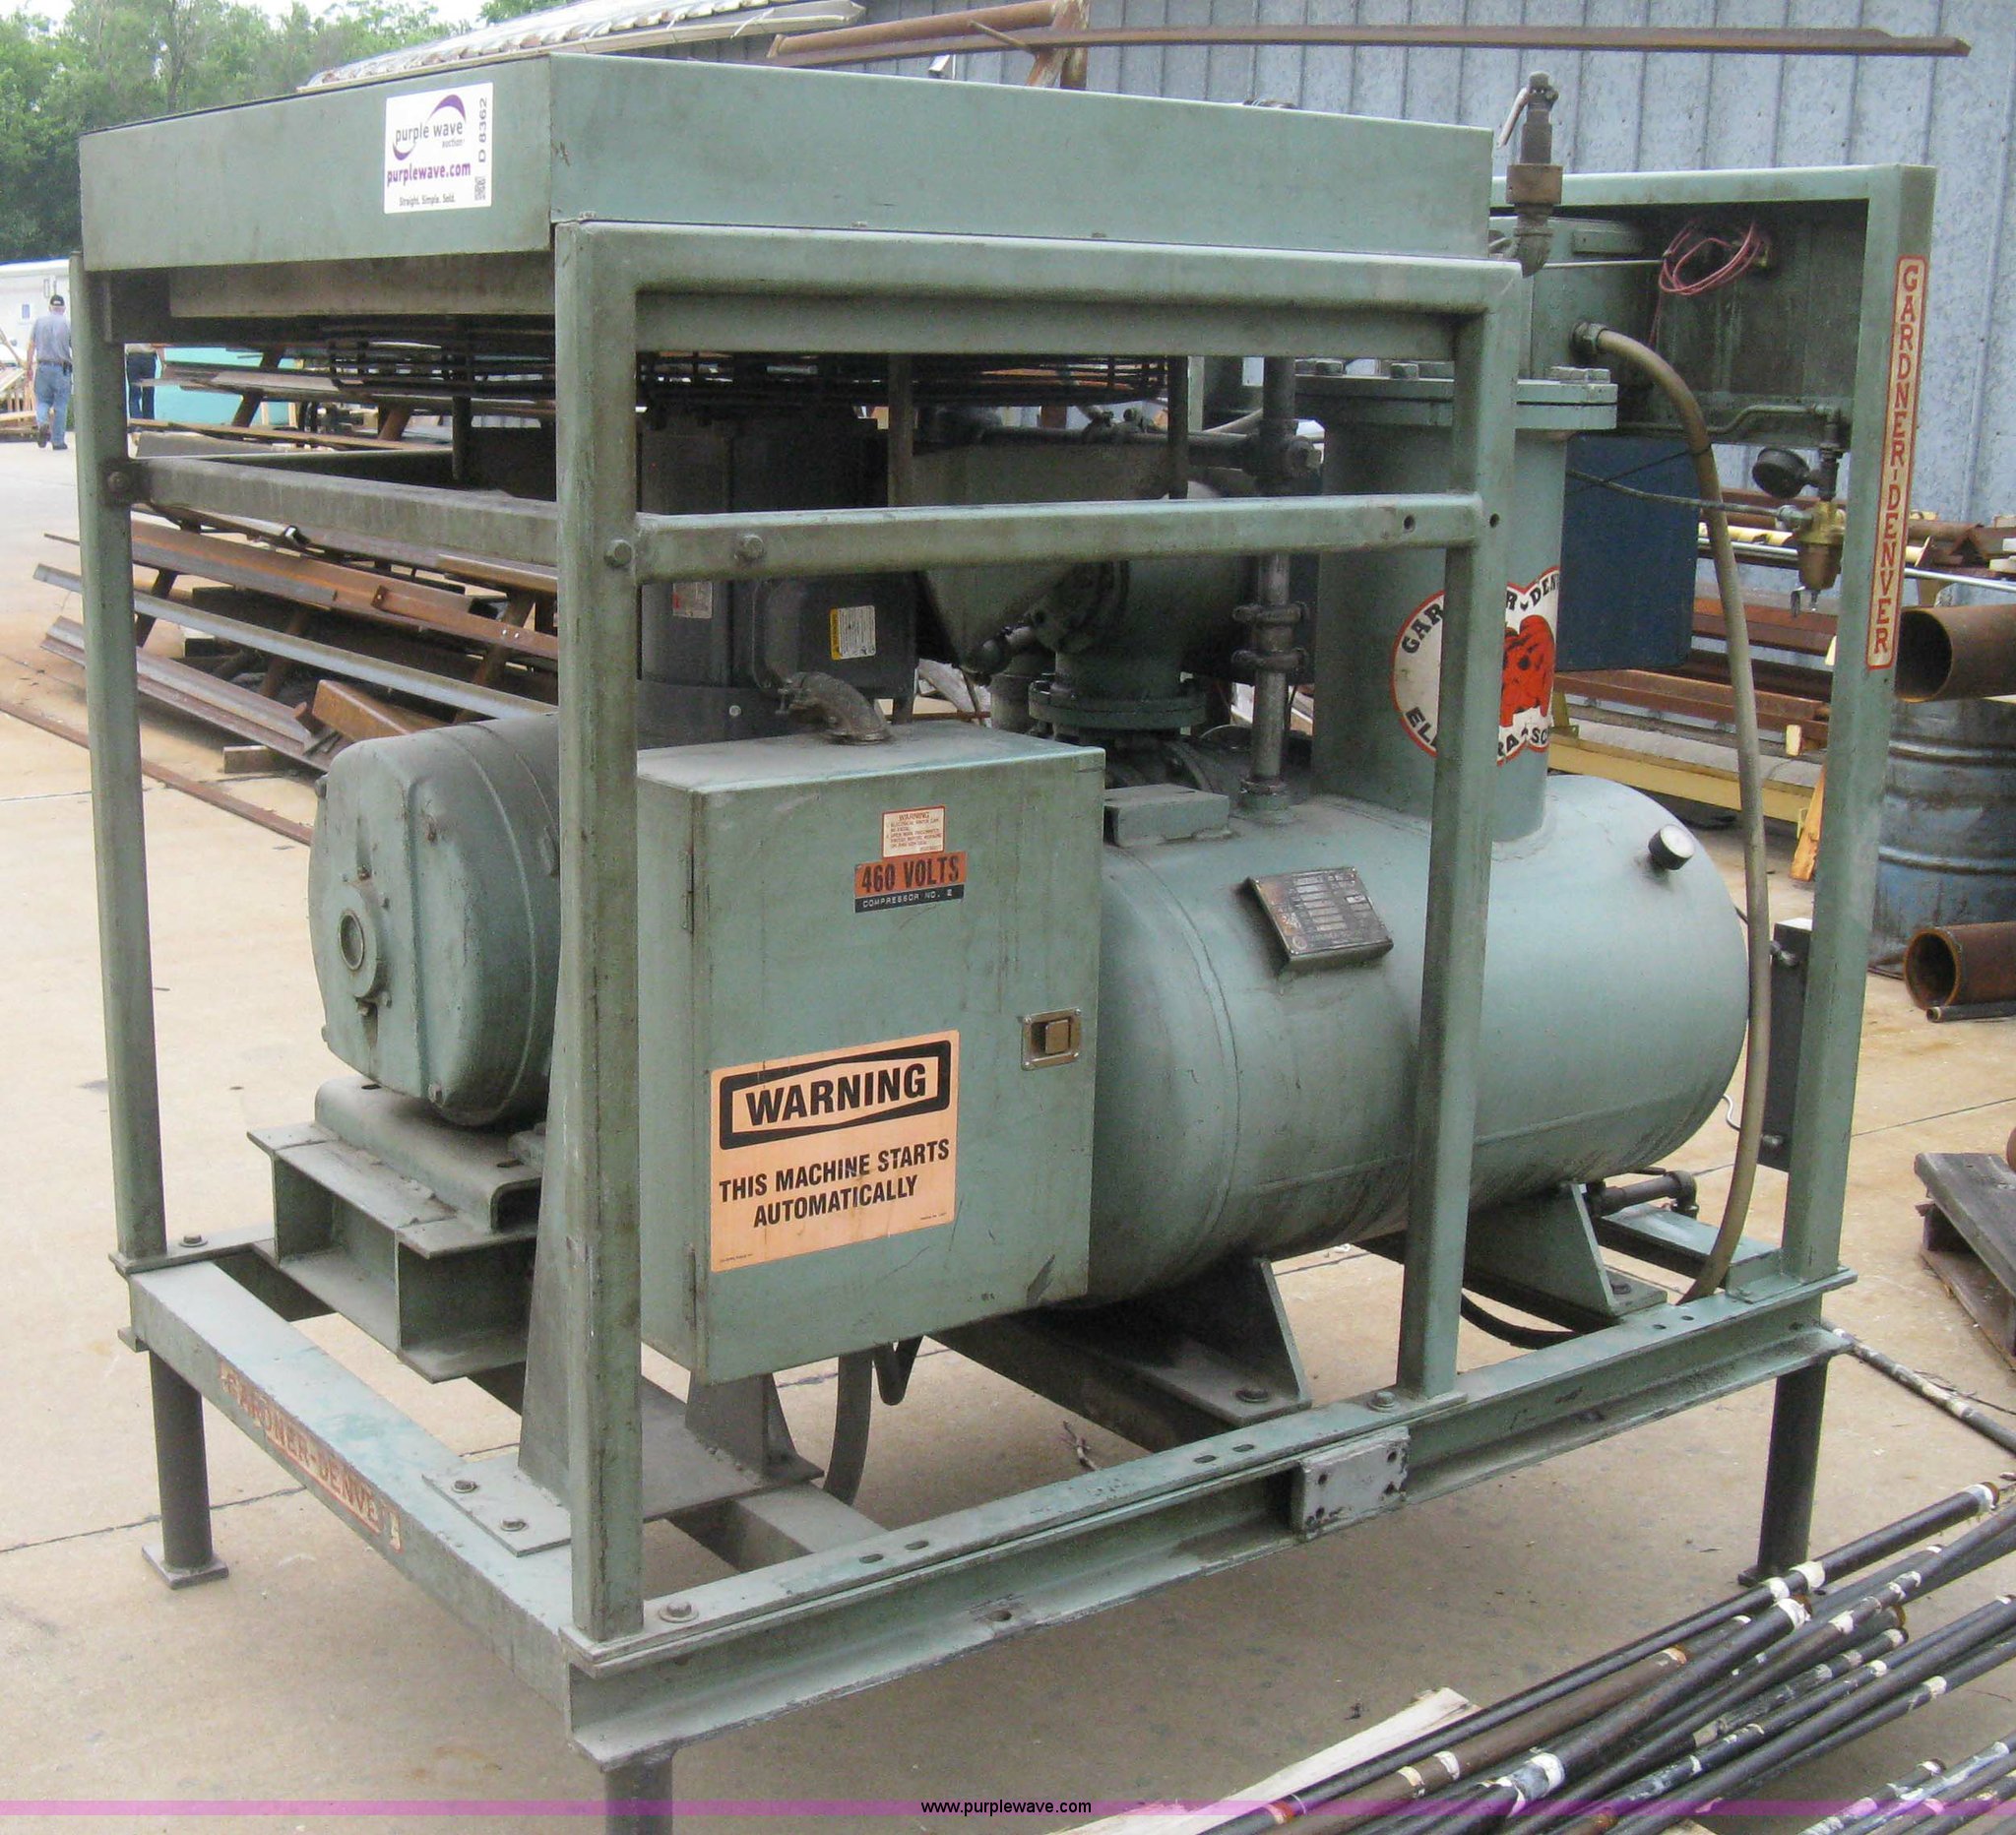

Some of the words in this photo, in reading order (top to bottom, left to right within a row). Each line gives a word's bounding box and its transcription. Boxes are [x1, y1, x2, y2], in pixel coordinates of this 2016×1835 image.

[396, 122, 429, 146] purple
[433, 121, 463, 138] wave
[477, 98, 487, 143] 8362
[387, 162, 471, 187] purplewave.com
[478, 150, 485, 162] D
[1873, 265, 1918, 655] GARDNER-DENVER
[861, 865, 896, 893] 460
[904, 855, 960, 887] VOLTS
[862, 893, 919, 908] COMPRESSOR
[745, 1063, 926, 1126] WARNING
[720, 1173, 768, 1202] THIS
[776, 1154, 870, 1192] MACHINE
[878, 1139, 950, 1171] STARTS
[753, 1174, 918, 1228] AUTOMATICALLY
